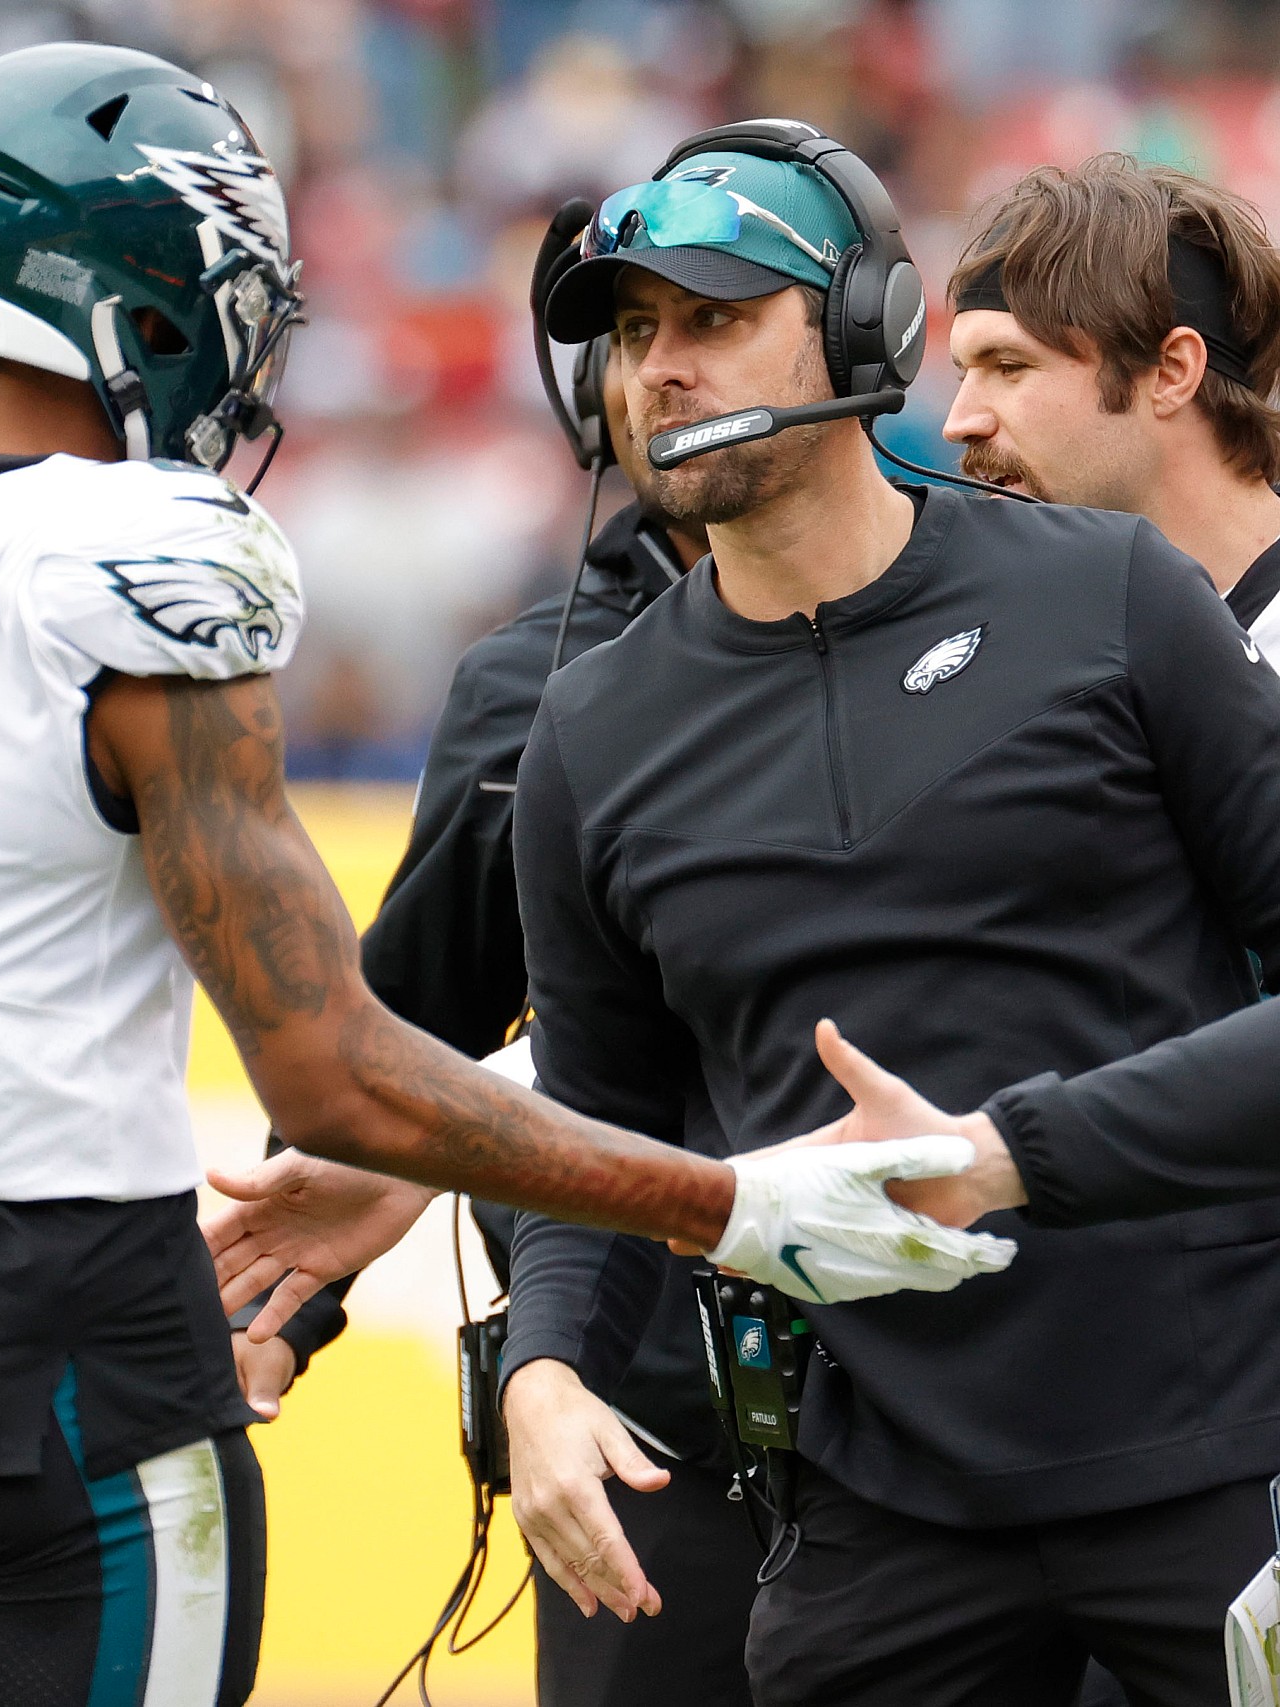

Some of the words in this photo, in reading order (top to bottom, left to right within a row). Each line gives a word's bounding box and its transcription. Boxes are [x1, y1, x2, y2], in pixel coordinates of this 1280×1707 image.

[660, 415, 762, 457] BOSE
[696, 1287, 722, 1399] BOSE
[751, 1411, 778, 1427] PATULLO
